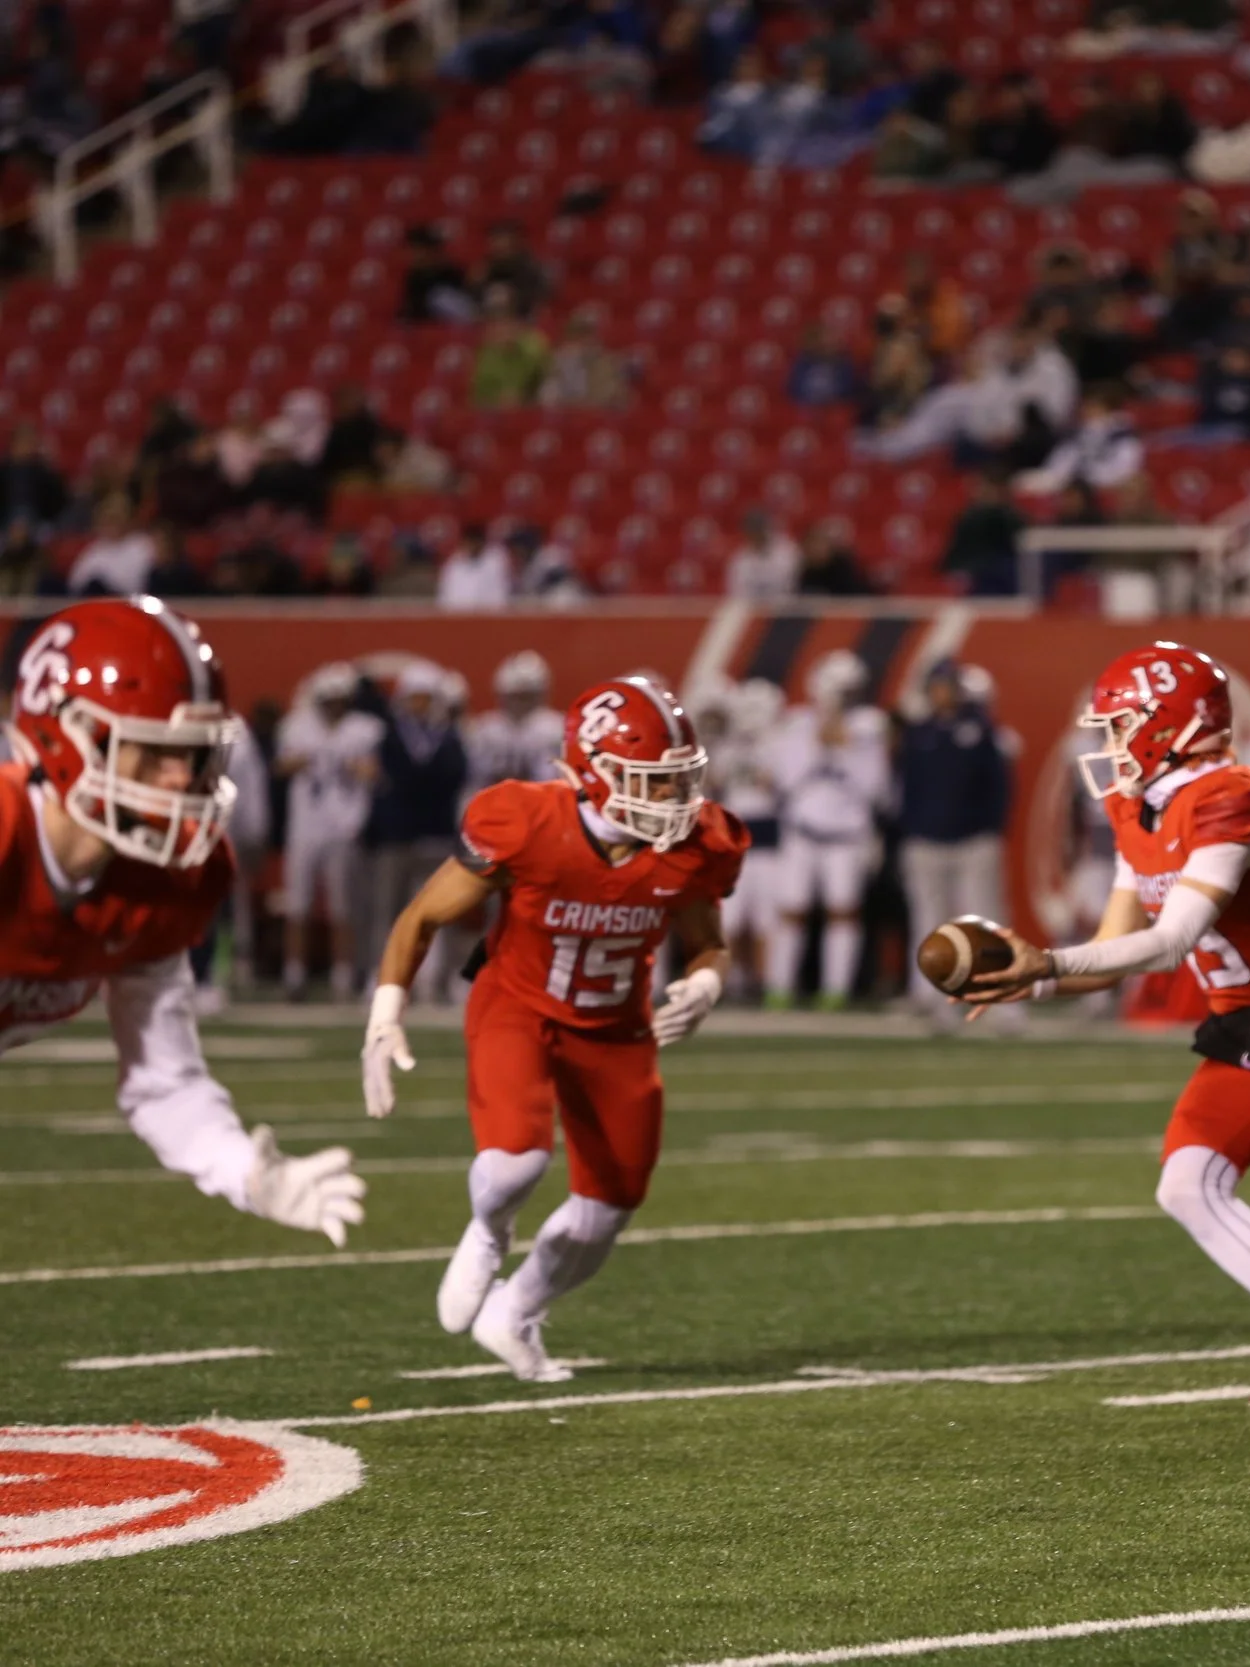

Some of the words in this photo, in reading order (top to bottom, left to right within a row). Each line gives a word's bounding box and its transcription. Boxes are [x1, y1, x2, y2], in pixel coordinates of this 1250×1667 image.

[1131, 660, 1178, 702] 13
[544, 899, 666, 934] CRIMSON
[546, 934, 645, 1008] 15
